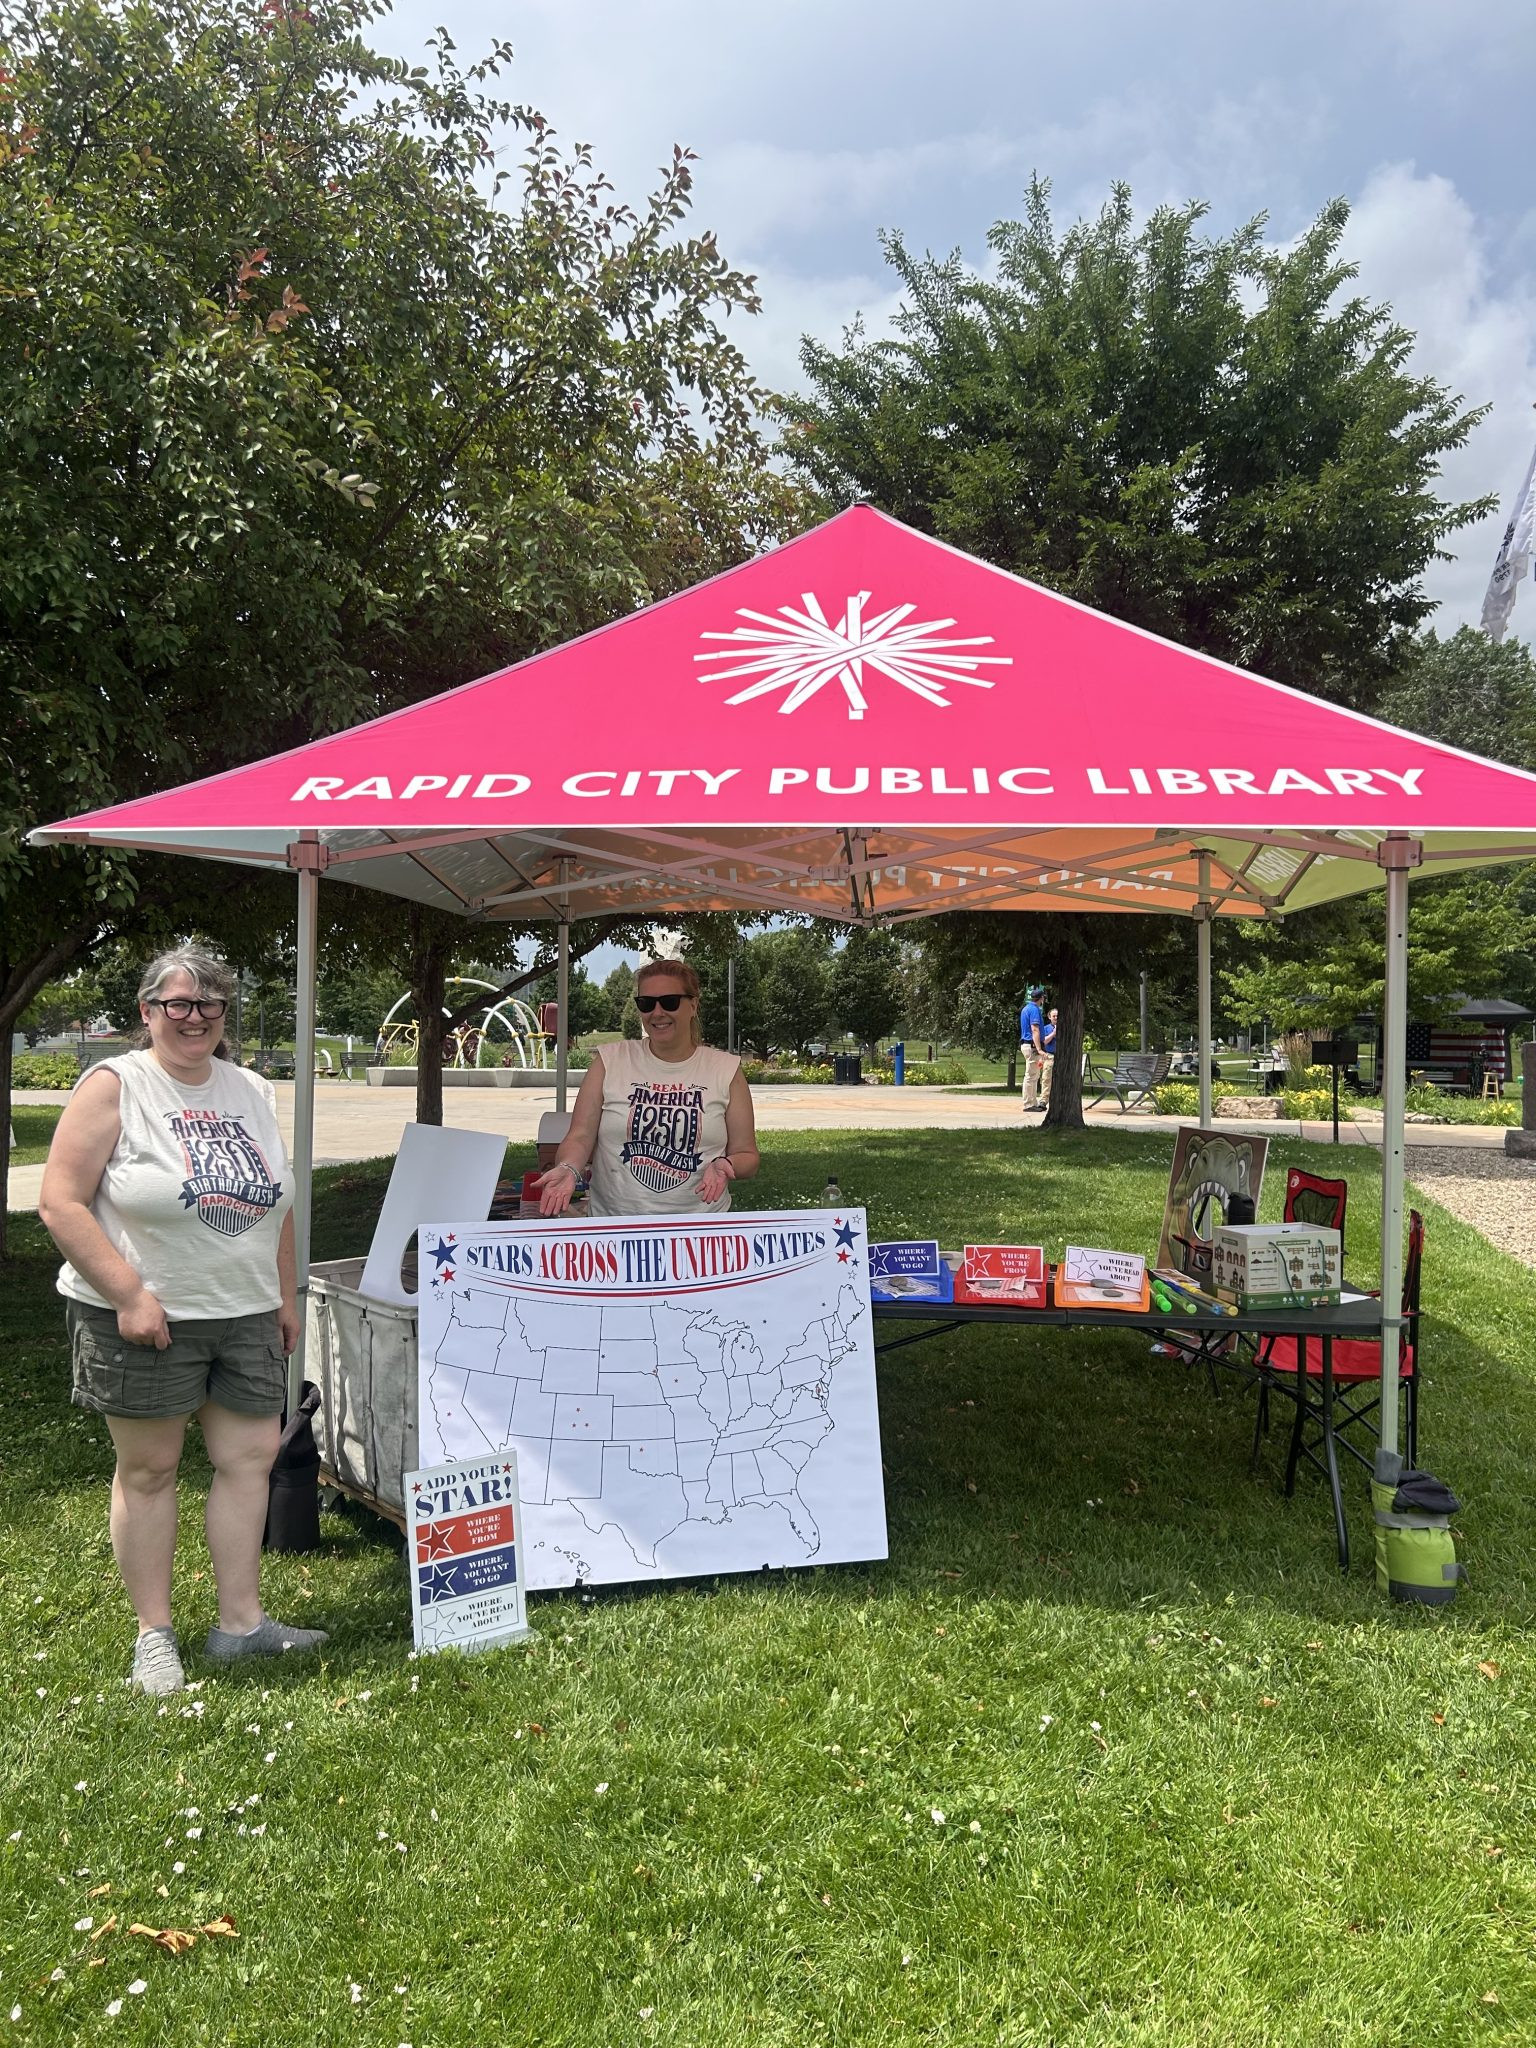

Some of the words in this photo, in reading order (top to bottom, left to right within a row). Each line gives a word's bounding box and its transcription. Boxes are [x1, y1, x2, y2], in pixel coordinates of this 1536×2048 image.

[290, 774, 531, 801] RAPID
[561, 769, 742, 797] CITY
[768, 767, 1055, 795] PUBLIC
[1086, 767, 1426, 796] LIBRARY
[652, 1083, 686, 1092] REAL
[628, 1088, 705, 1114] AMERICA
[183, 1109, 220, 1120] REAL
[169, 1117, 259, 1142] AMERICA
[641, 1105, 689, 1152] 250
[195, 1140, 258, 1183] 250
[628, 1143, 671, 1161] BIRTHDAY
[671, 1154, 694, 1170] BASH
[633, 1157, 658, 1168] RAPID
[657, 1165, 678, 1177] CITY
[188, 1176, 246, 1195] BIRTHDAY
[247, 1185, 274, 1204] BASH
[201, 1195, 232, 1207] RAPID
[233, 1200, 254, 1215] CITY
[254, 1206, 266, 1216] SD
[466, 1243, 533, 1278] STARS
[536, 1240, 618, 1282] ACROSS
[621, 1238, 667, 1283] THE
[670, 1234, 749, 1281] UNITED
[753, 1231, 826, 1269] STATES
[893, 1255, 909, 1263] YOU
[1000, 1252, 1031, 1260] WHERE
[1108, 1258, 1134, 1268] WHERE
[1004, 1267, 1027, 1275] FROM
[1109, 1274, 1131, 1282] ABOUT
[425, 1474, 457, 1490] ADD
[460, 1464, 500, 1483] YOUR
[416, 1476, 512, 1520] STAR!
[466, 1513, 501, 1528] WHERE
[467, 1523, 501, 1537] YOU'RE
[472, 1532, 498, 1545] FROM
[468, 1554, 504, 1569] WHERE
[463, 1567, 483, 1580] YOU
[483, 1562, 509, 1576] WANT
[473, 1576, 486, 1586] TO
[487, 1574, 501, 1584] GO
[468, 1596, 503, 1611] WHERE
[456, 1608, 489, 1623] YOU'VE
[490, 1602, 514, 1616] READ
[471, 1615, 502, 1629] ABOUT
